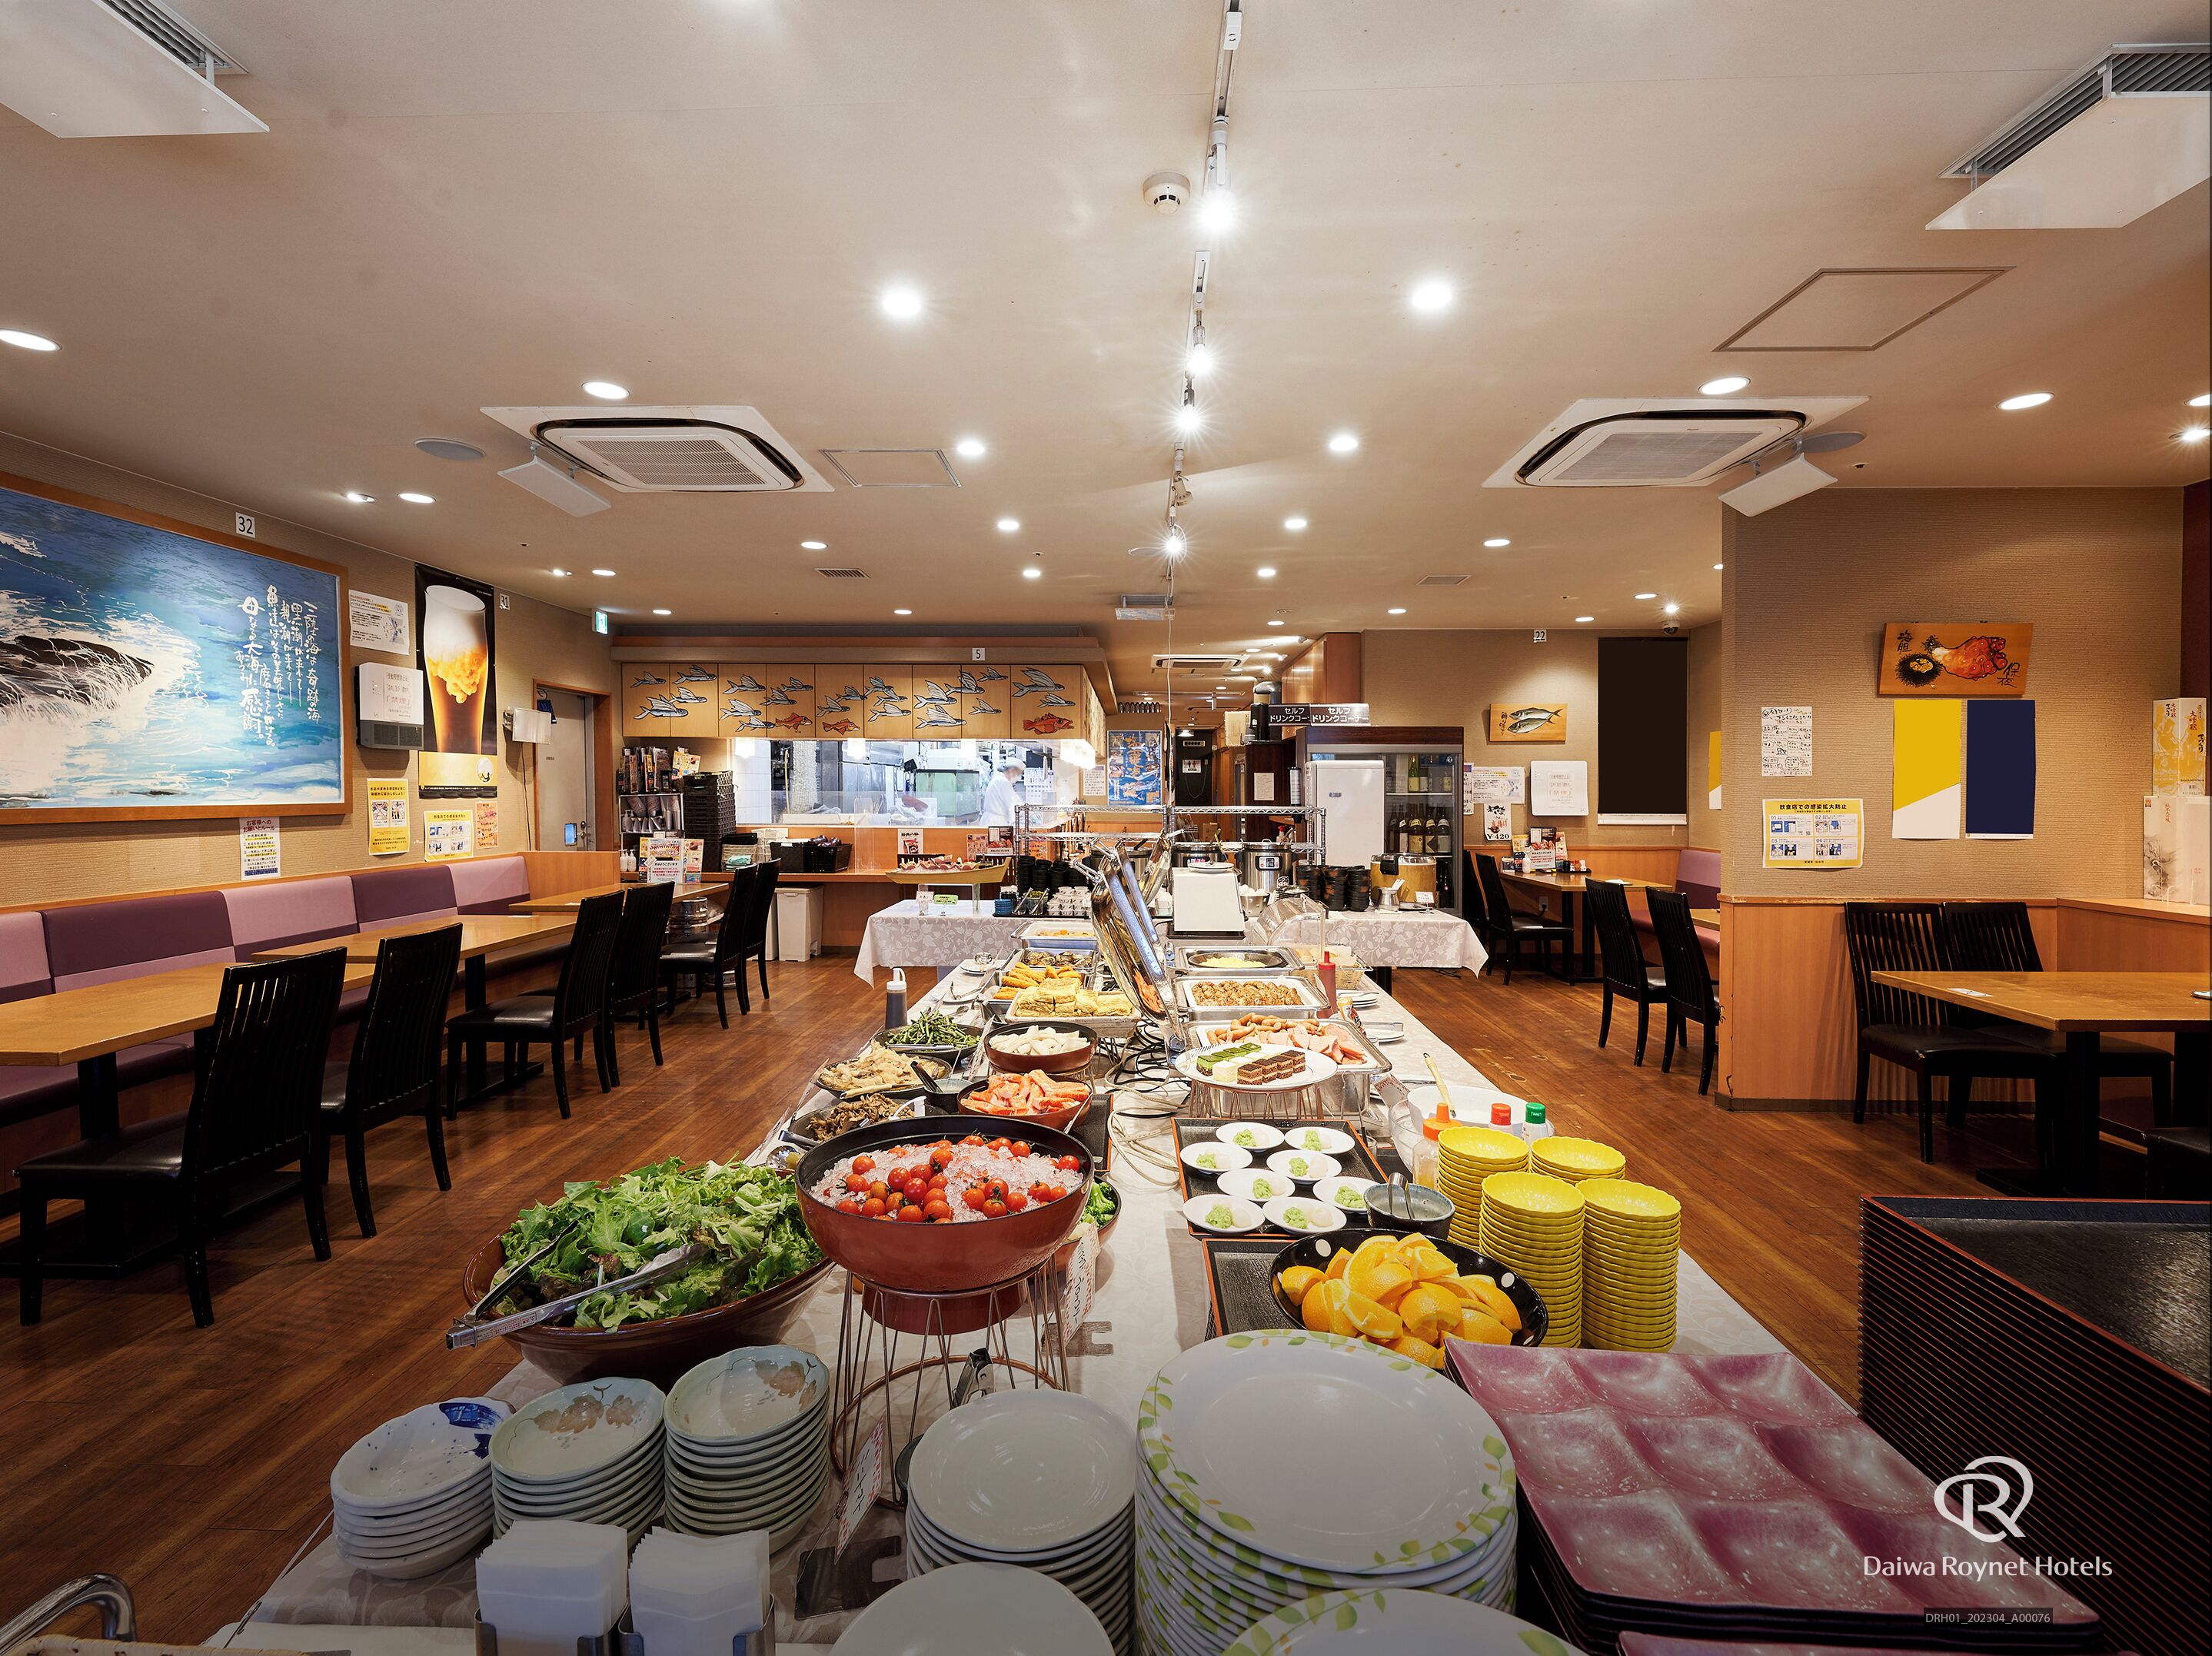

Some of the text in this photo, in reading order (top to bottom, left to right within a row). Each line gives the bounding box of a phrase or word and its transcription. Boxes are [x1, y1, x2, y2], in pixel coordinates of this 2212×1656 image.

[238, 517, 254, 536] 32
[1535, 630, 1545, 641] 22
[1897, 629, 1912, 655] 海胆
[974, 648, 982, 660] 5
